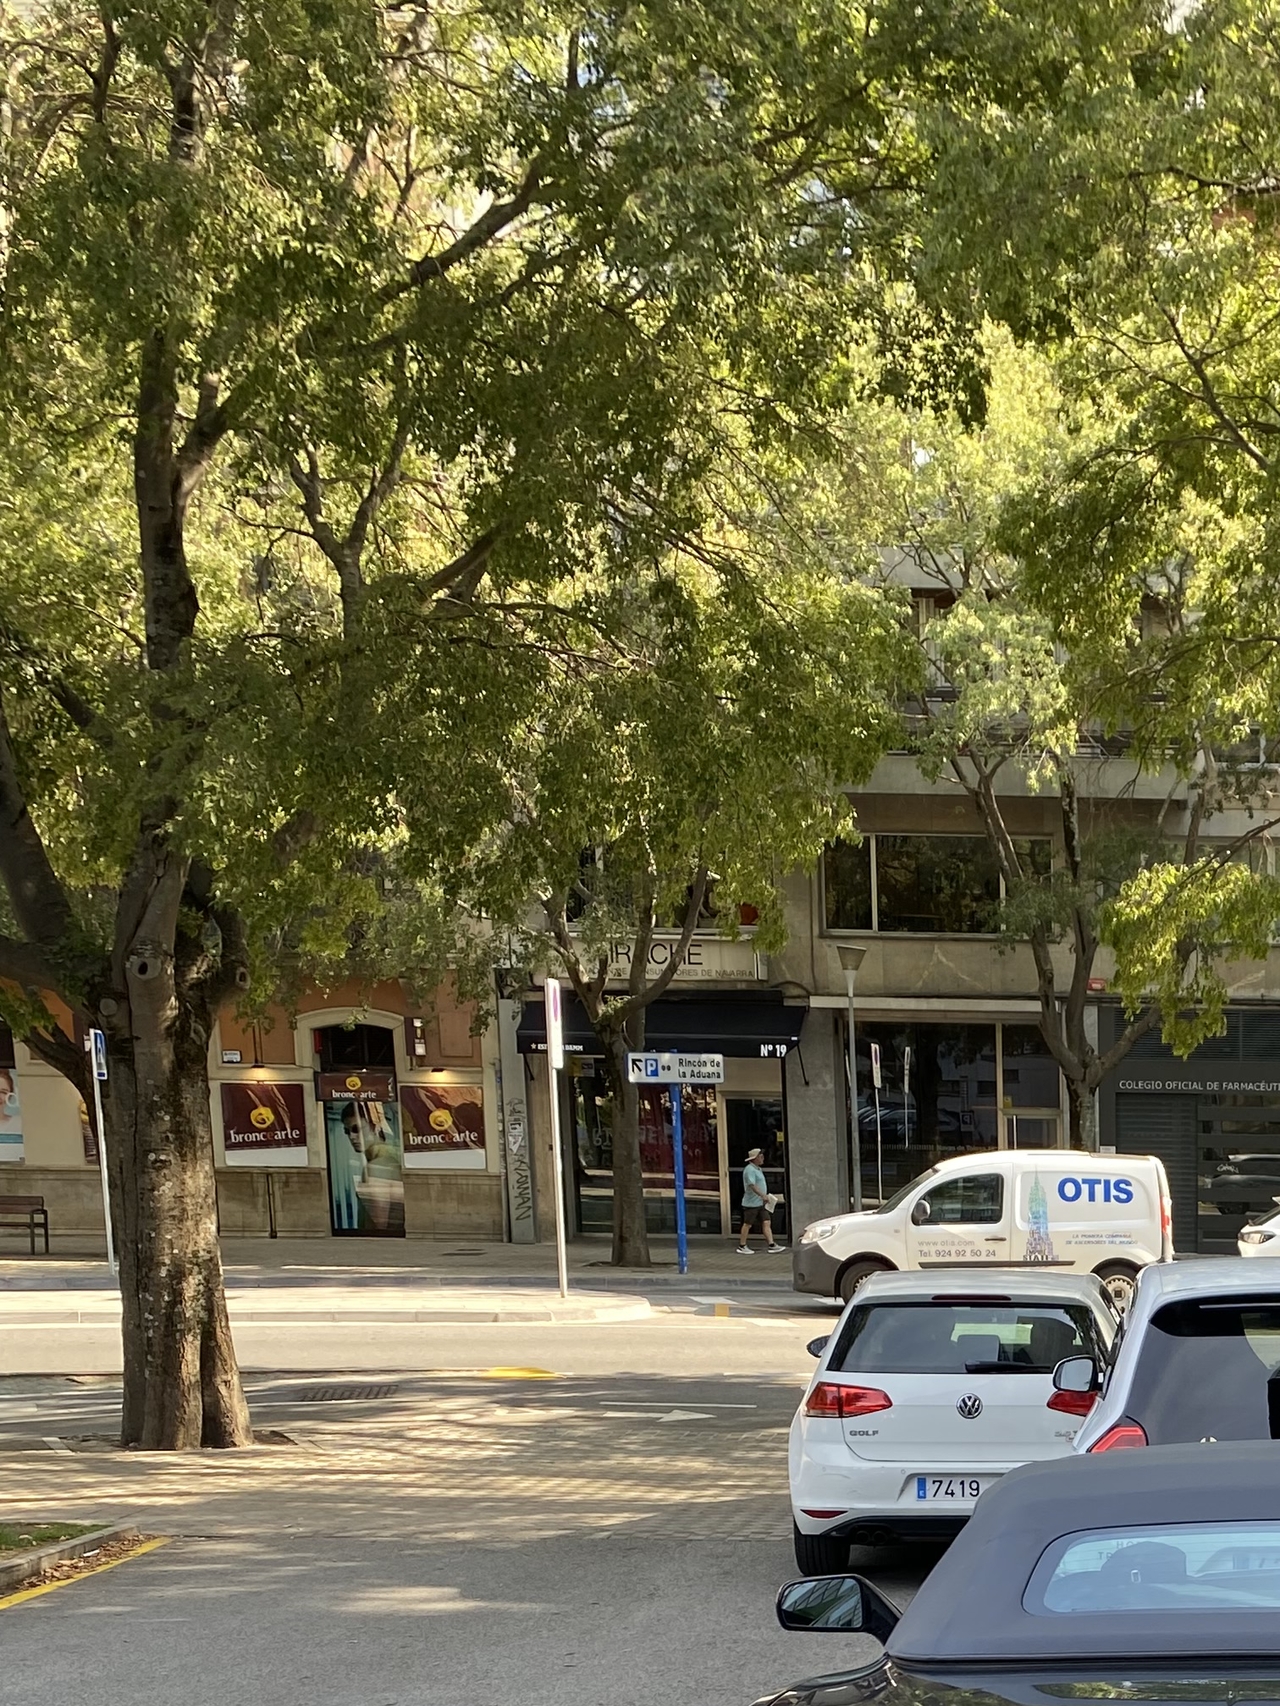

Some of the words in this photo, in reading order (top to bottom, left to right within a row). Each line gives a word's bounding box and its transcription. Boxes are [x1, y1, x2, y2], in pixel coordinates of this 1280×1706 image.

[610, 943, 703, 966] IRCHE
[701, 969, 713, 978] DE
[760, 1045, 773, 1057] Nº
[775, 1045, 787, 1057] 19
[678, 1058, 707, 1068] Rincón
[710, 1058, 721, 1068] de
[678, 1070, 687, 1079] la
[690, 1070, 721, 1079] Aduana
[1119, 1080, 1163, 1090] COLEGIO
[1165, 1080, 1204, 1091] OFICIAL
[1206, 1081, 1220, 1091] DE
[230, 1128, 301, 1144] broncearte
[408, 1130, 479, 1146] broncearte
[1057, 1177, 1134, 1204] OTIS
[918, 1249, 933, 1257] Tel.
[935, 1249, 952, 1258] 924
[954, 1249, 967, 1258] 92
[970, 1249, 982, 1257] 50
[985, 1249, 996, 1257] 24
[932, 1479, 980, 1498] 7419
